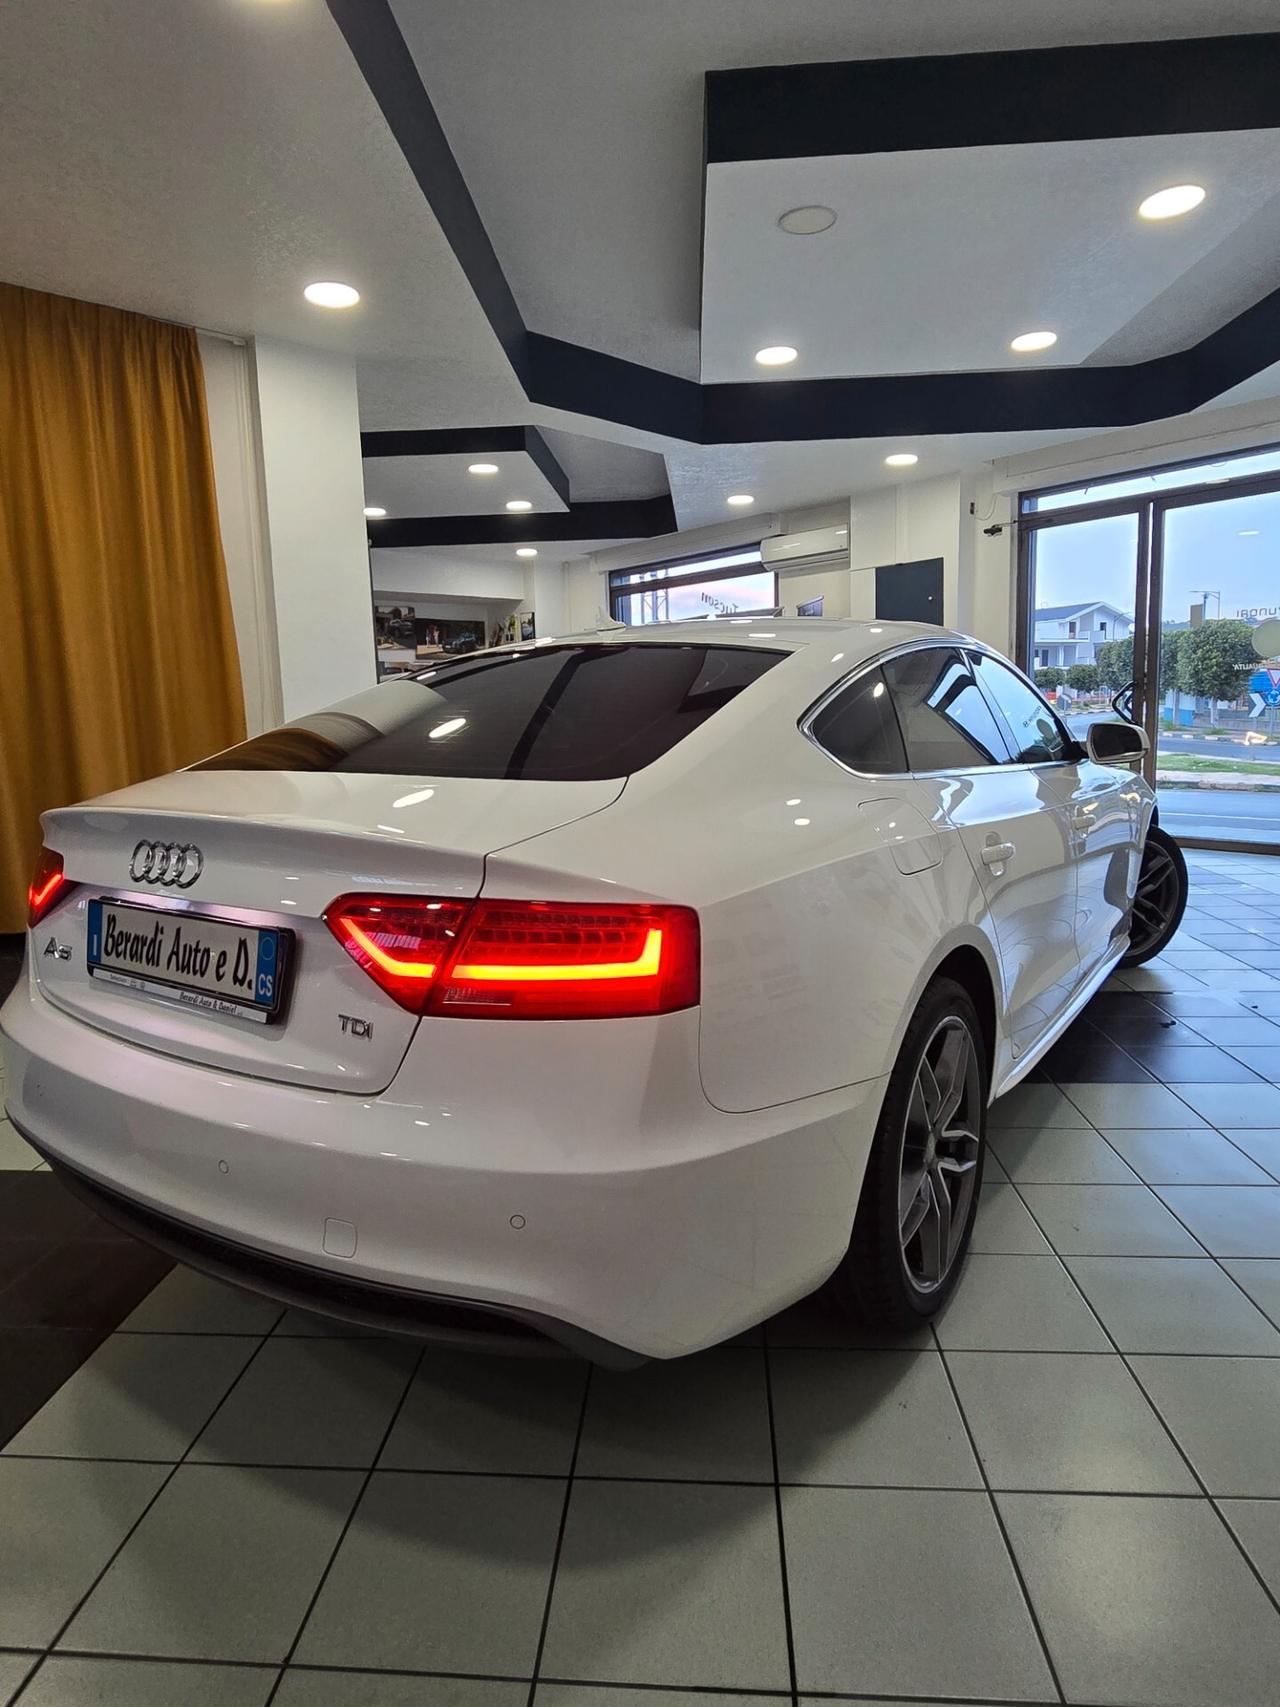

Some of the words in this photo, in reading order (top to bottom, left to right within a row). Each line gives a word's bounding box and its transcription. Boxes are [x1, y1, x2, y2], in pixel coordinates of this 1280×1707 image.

[43, 936, 73, 961] A5
[104, 913, 164, 968] Berardi
[167, 926, 211, 978] Auto
[215, 950, 227, 982] e
[232, 937, 252, 990] D.
[258, 973, 273, 997] CS
[338, 1013, 374, 1039] TDI
